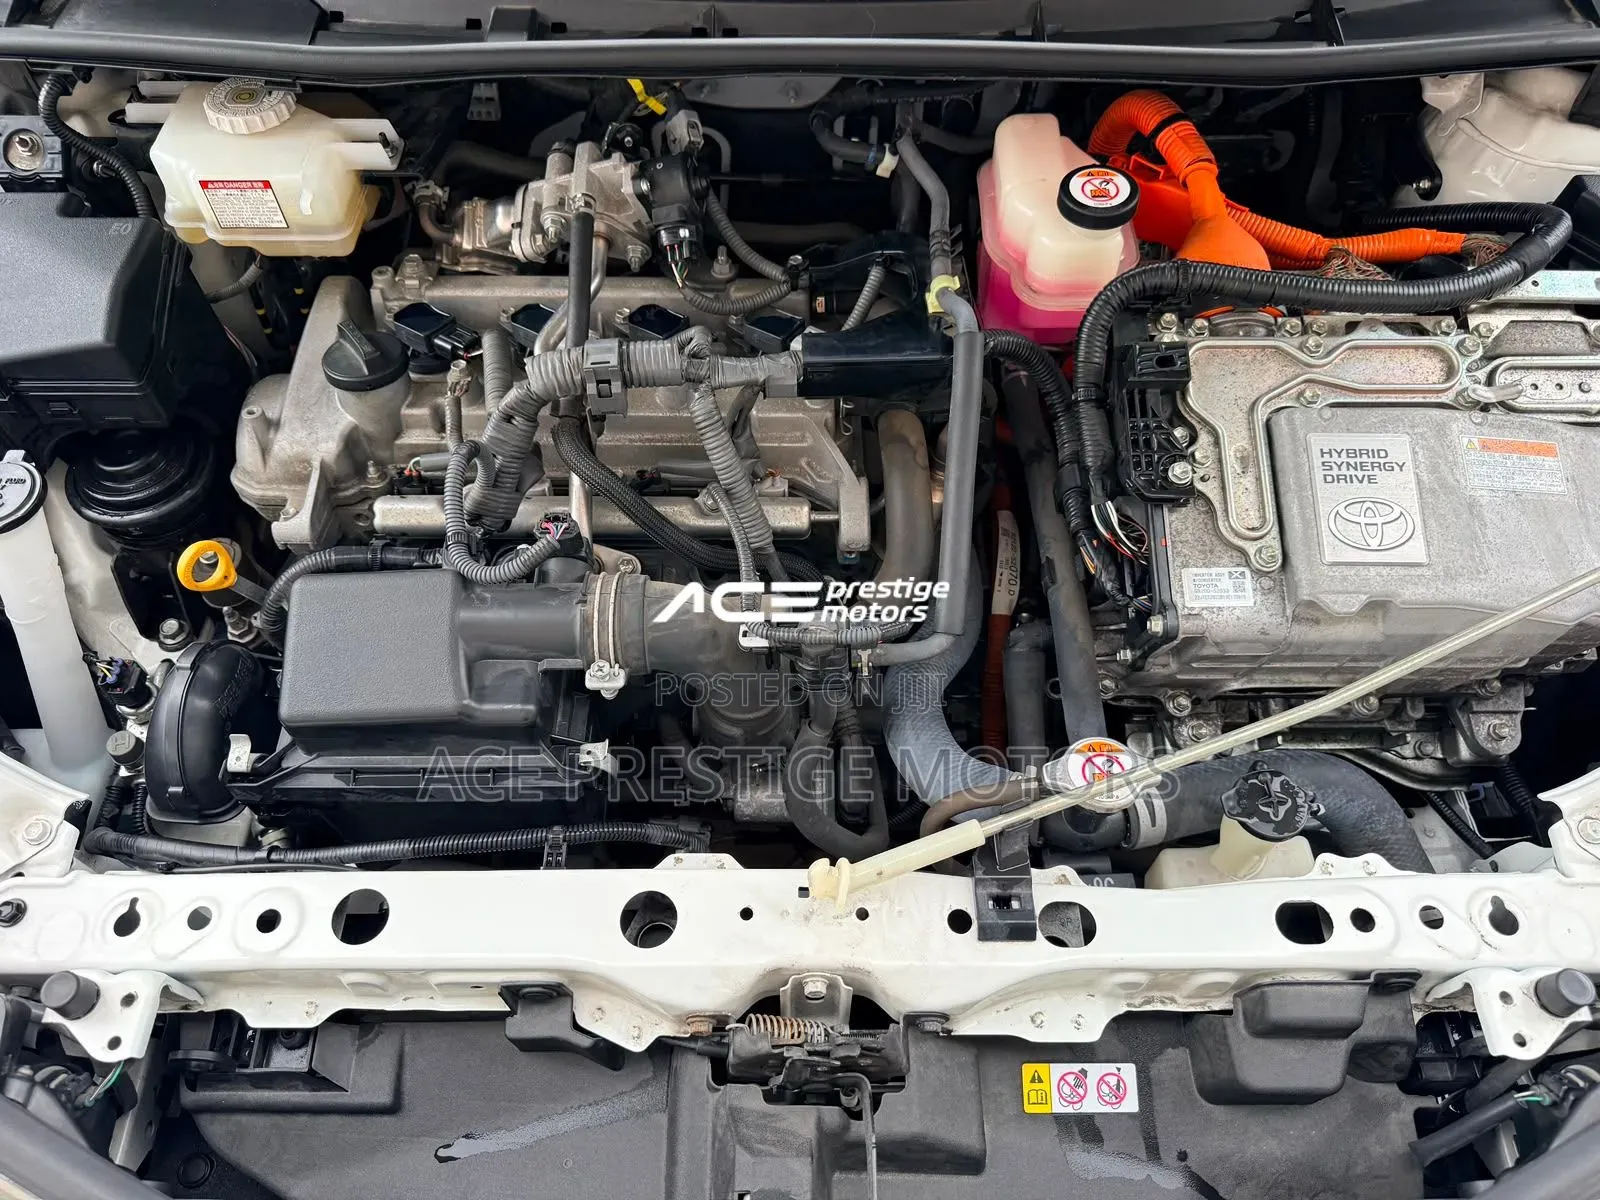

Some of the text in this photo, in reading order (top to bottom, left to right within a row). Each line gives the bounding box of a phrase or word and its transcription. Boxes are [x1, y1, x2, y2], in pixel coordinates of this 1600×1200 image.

[1320, 448, 1389, 459] HYBRID
[1321, 461, 1406, 472] SYNERGY
[1323, 474, 1379, 485] DRIVE
